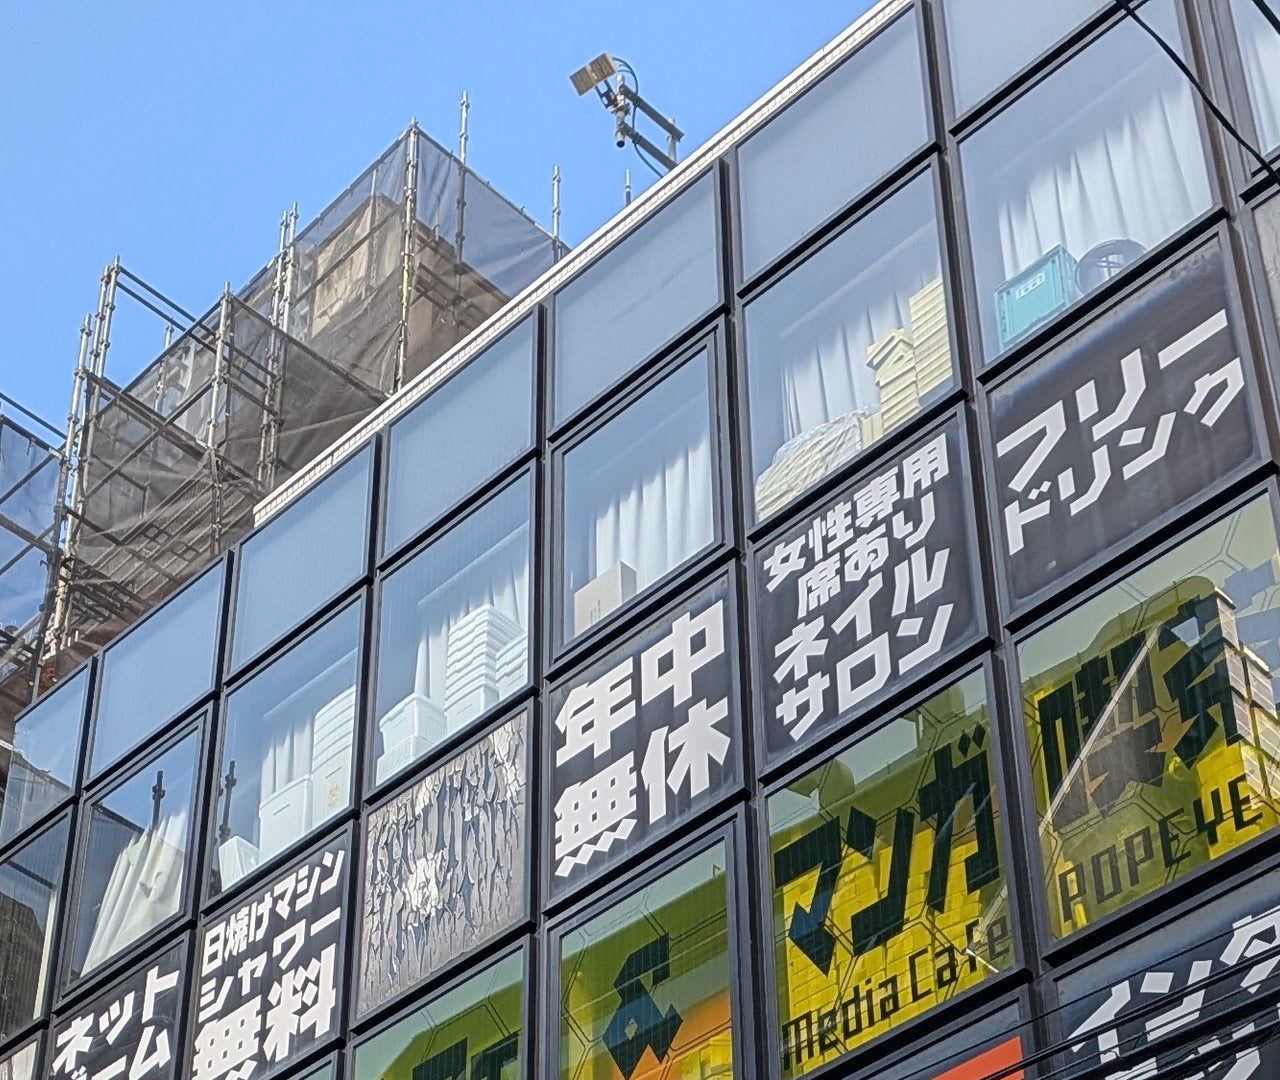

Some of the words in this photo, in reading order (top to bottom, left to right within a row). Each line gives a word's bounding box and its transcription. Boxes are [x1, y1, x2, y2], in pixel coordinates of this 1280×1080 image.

[997, 310, 1228, 493] フリー
[1006, 357, 1245, 556] ドリンク
[764, 432, 949, 593] 女性専用
[797, 494, 935, 621] 席あり
[555, 599, 725, 768] 年中
[774, 547, 950, 686] ネイル
[775, 604, 955, 741] サロン
[554, 696, 731, 878] 無休
[773, 722, 1001, 978] マンガ
[1058, 772, 1264, 925] POPEYE
[198, 907, 341, 1024] シャワー
[201, 849, 345, 978] 日焼けマシン
[52, 965, 181, 1076] ネット
[781, 970, 900, 1071] Media
[909, 914, 1011, 997] Cafe
